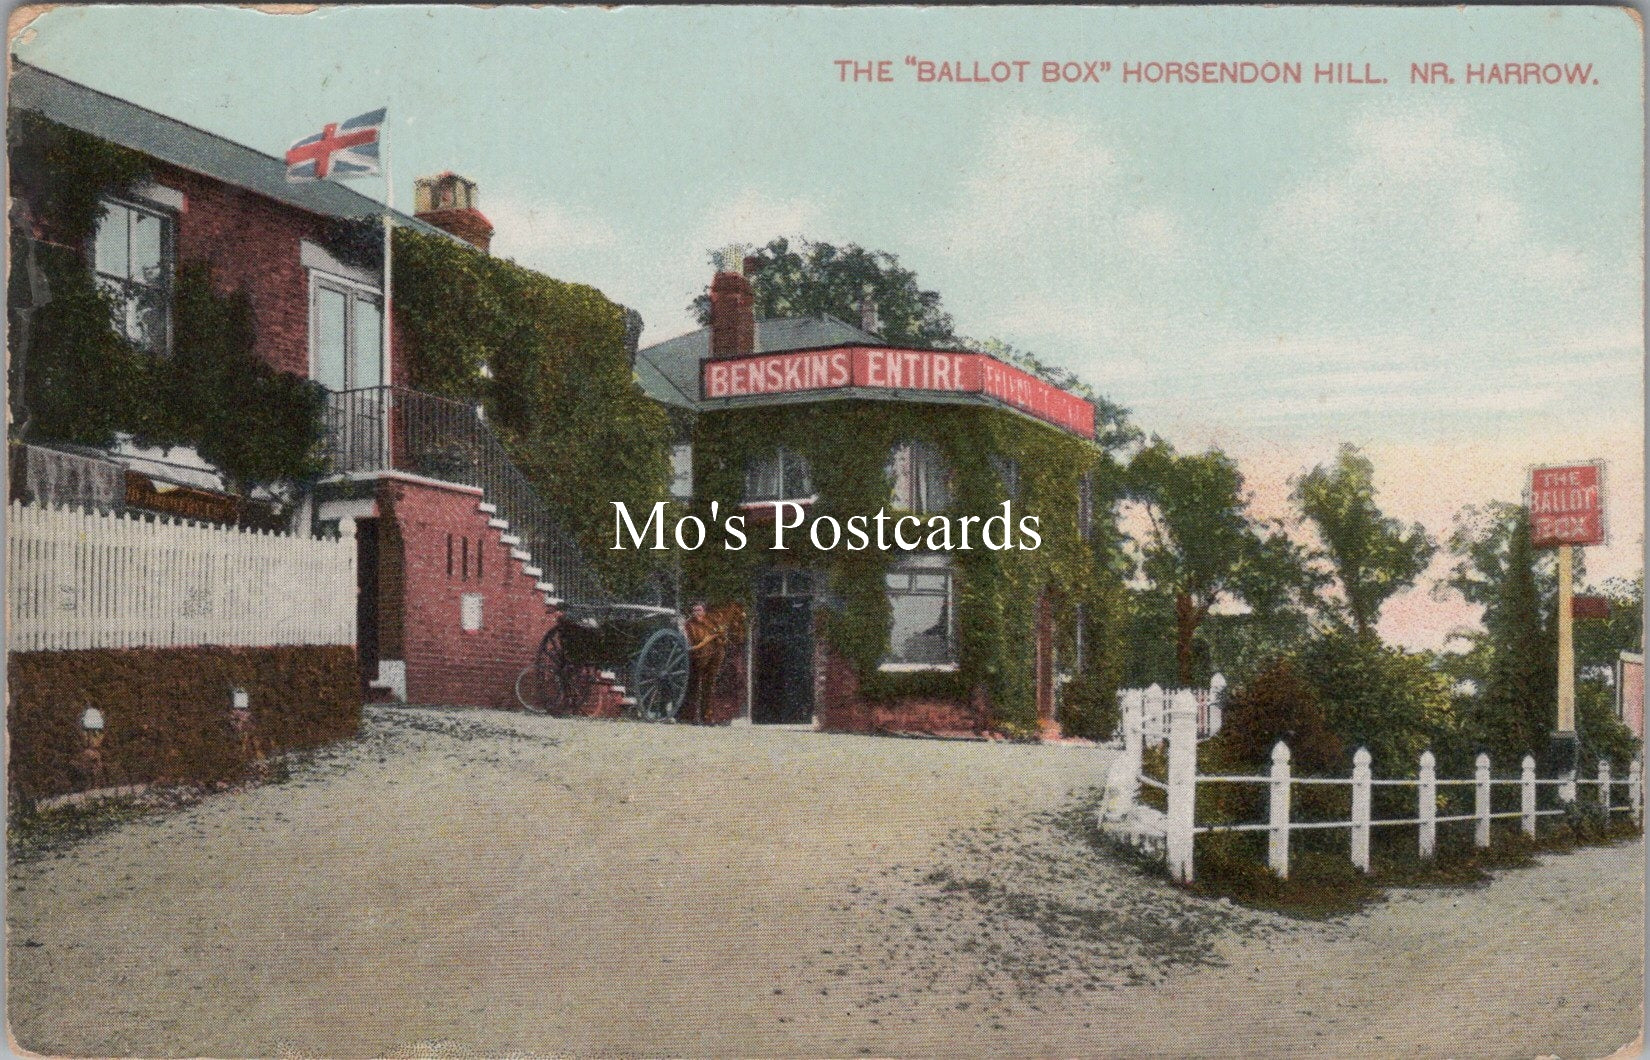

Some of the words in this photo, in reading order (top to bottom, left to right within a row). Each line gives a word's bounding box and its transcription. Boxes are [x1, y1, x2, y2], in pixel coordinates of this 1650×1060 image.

[710, 353, 850, 398] BENSKINS
[867, 351, 965, 390] ENTIRE
[1540, 471, 1581, 488] THE
[1532, 485, 1599, 514] BALLOT
